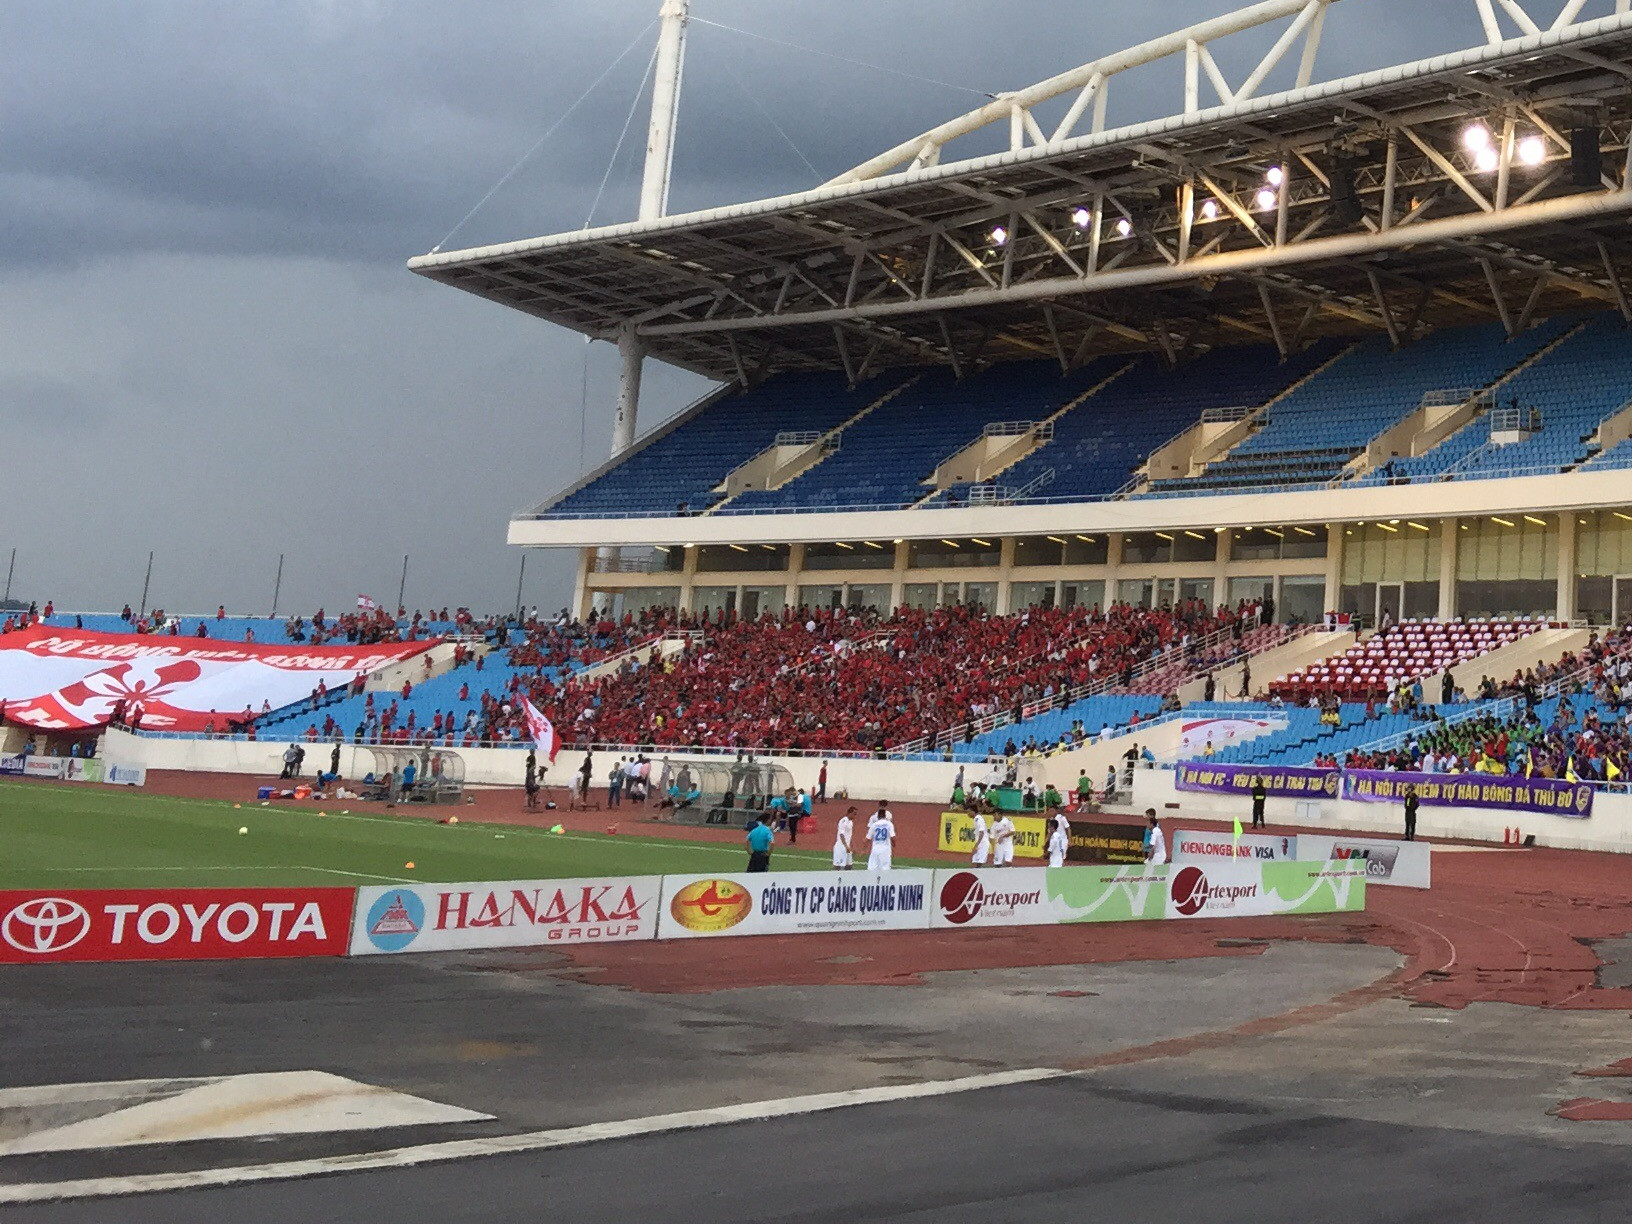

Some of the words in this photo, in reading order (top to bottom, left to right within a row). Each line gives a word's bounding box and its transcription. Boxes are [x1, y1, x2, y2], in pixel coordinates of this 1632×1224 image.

[874, 827, 888, 841] 29
[1254, 846, 1275, 859] VISA
[432, 885, 653, 931] HANAKA
[761, 882, 791, 916] CÔNG
[795, 886, 808, 914] TY
[810, 886, 824, 913] CP
[827, 877, 857, 913] CẢNG
[859, 876, 895, 915] QUẢNG
[898, 884, 925, 912] NINH
[104, 902, 327, 944] TOYOTA
[548, 925, 639, 940] GROUP
